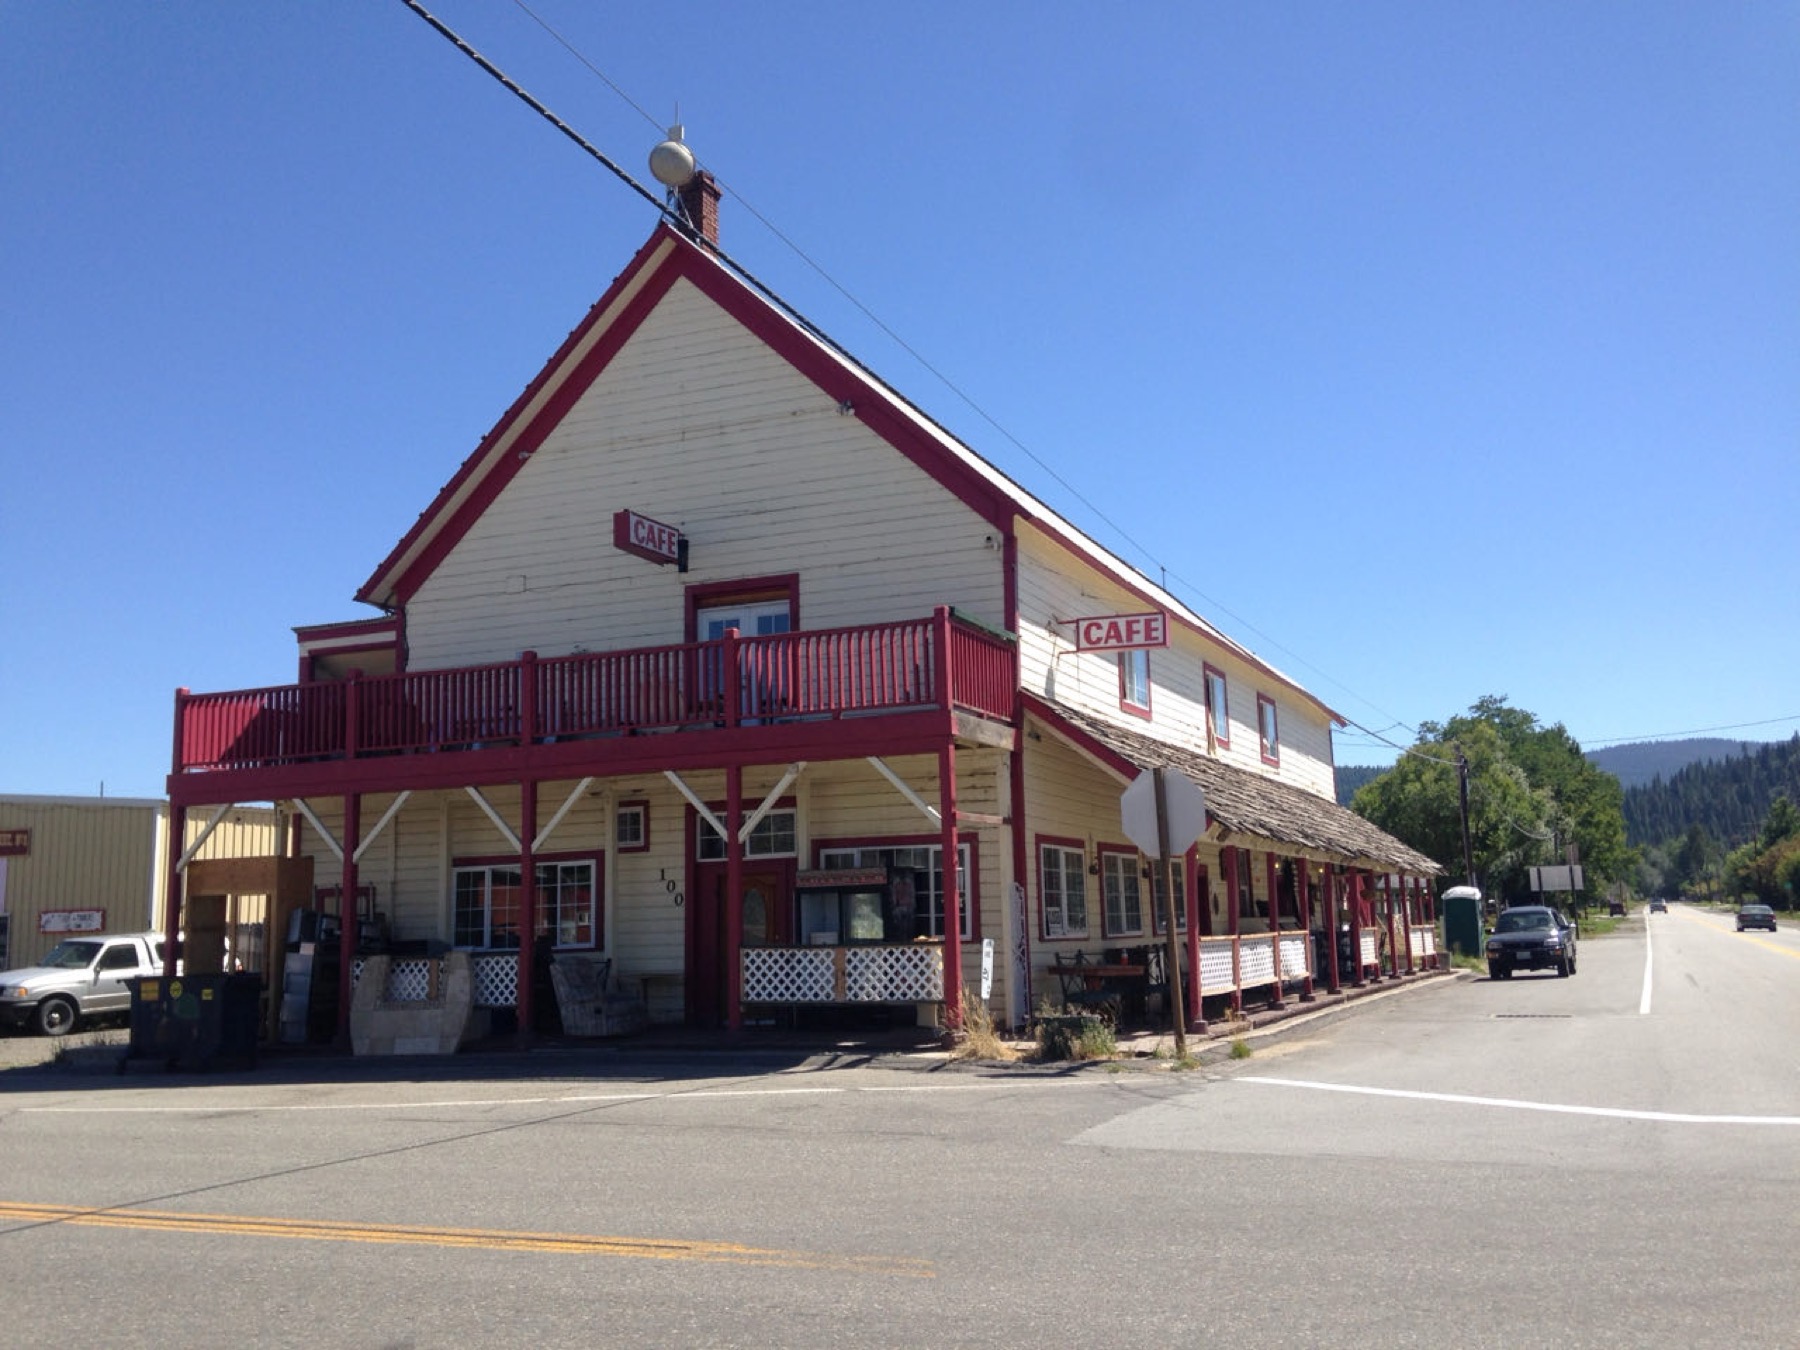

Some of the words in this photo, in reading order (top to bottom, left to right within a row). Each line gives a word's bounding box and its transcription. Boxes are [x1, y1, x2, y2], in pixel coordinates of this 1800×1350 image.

[634, 519, 676, 555] CAFE
[1083, 618, 1160, 645] CAFE
[660, 868, 684, 907] 100
